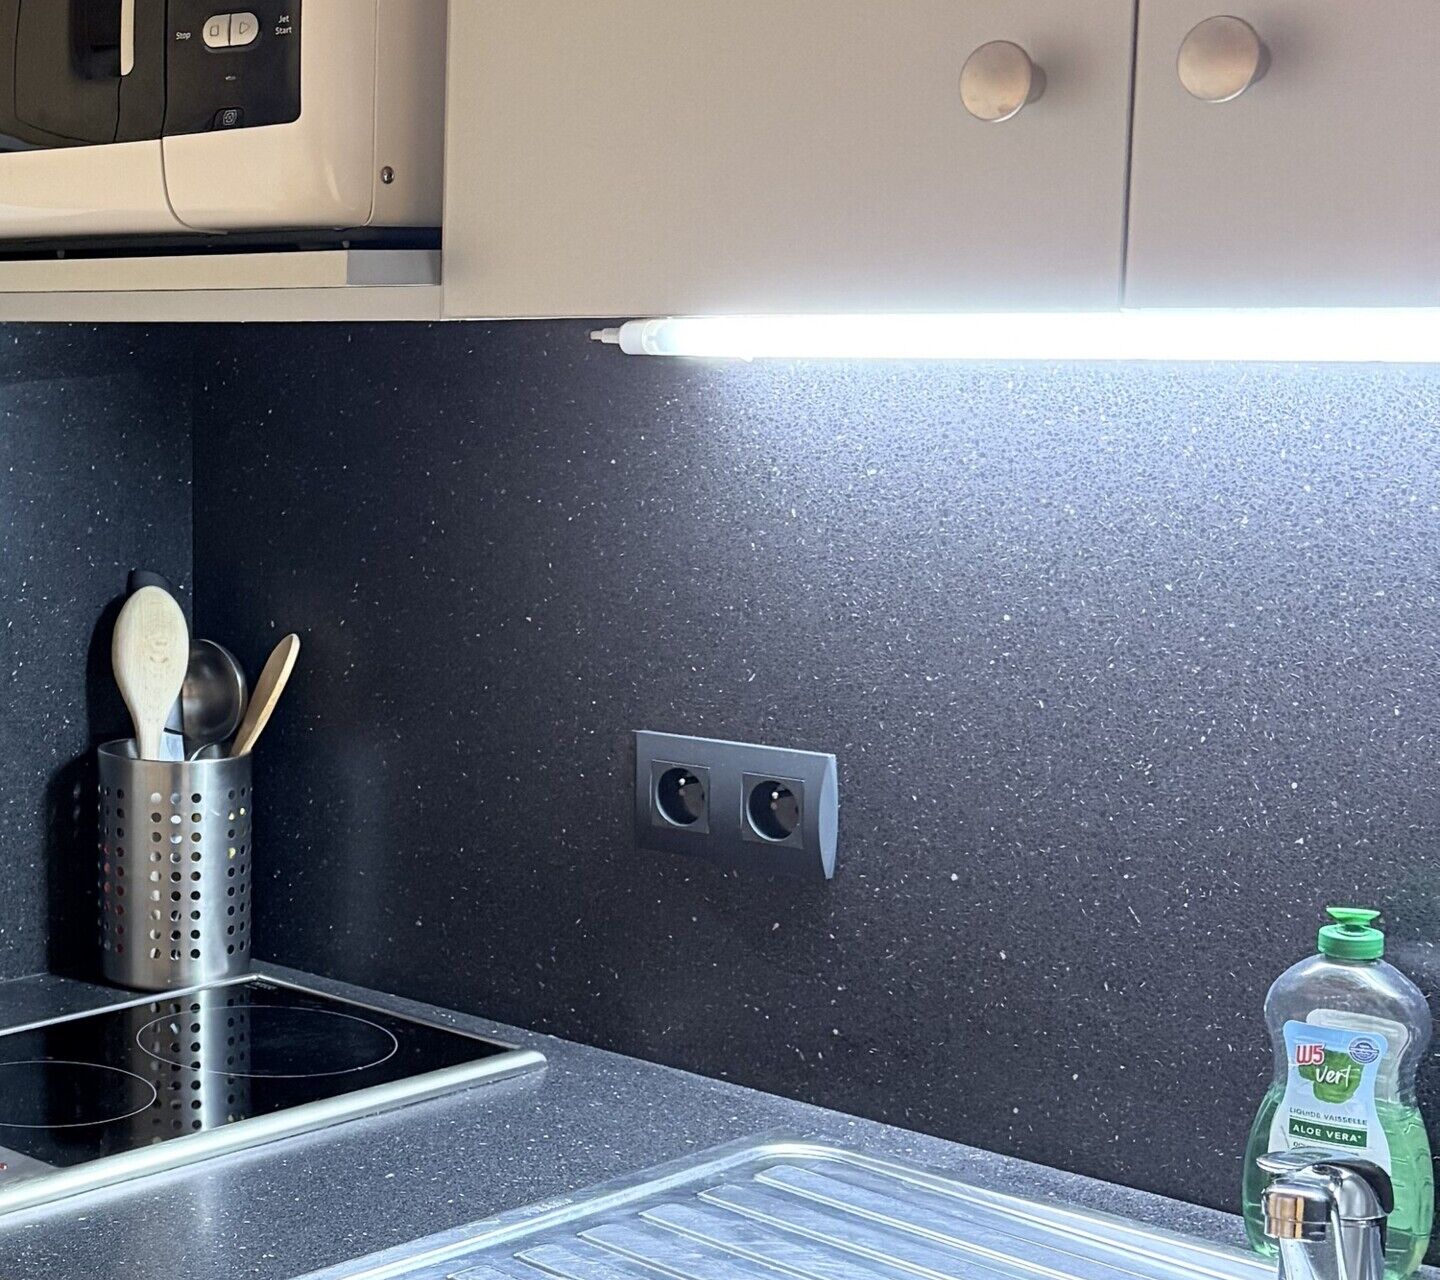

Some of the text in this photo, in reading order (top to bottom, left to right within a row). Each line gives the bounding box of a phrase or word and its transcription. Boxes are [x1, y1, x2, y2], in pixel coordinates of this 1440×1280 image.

[278, 15, 290, 24] Jet
[176, 31, 192, 41] Stop
[275, 26, 293, 36] Start
[1297, 1043, 1325, 1065] W5
[1315, 1064, 1360, 1087] vert
[1290, 1106, 1368, 1126] LIQUIDE VAISSELLE
[1292, 1124, 1322, 1137] ALOE
